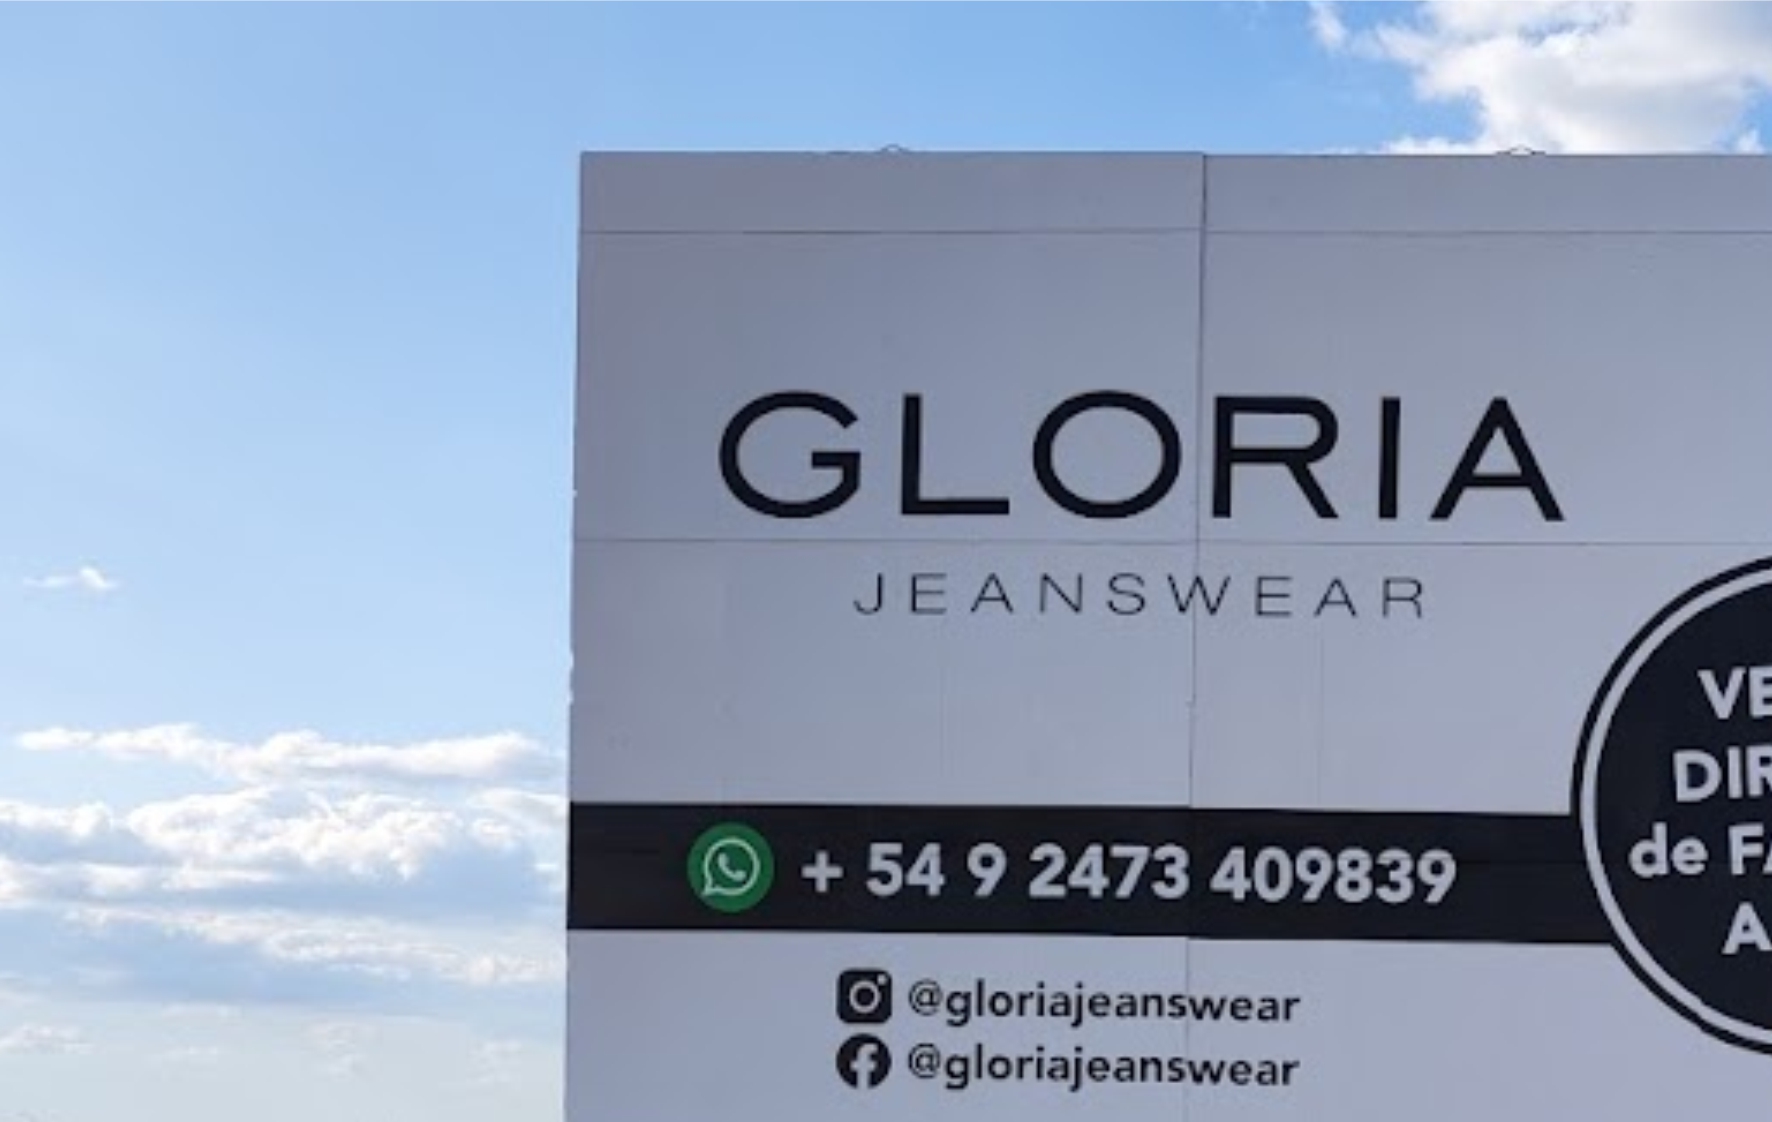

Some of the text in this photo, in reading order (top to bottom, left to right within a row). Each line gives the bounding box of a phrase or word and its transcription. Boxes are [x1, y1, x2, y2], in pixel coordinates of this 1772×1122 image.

[718, 389, 1564, 522] GLORIA
[856, 573, 1422, 616] JEANSWEAR
[802, 843, 1456, 903] + 54 9 2473 409839
[1629, 822, 1708, 878] de
[908, 979, 1301, 1028] @gloriajeanswear
[907, 1042, 1299, 1093] @gloriajeanswear
